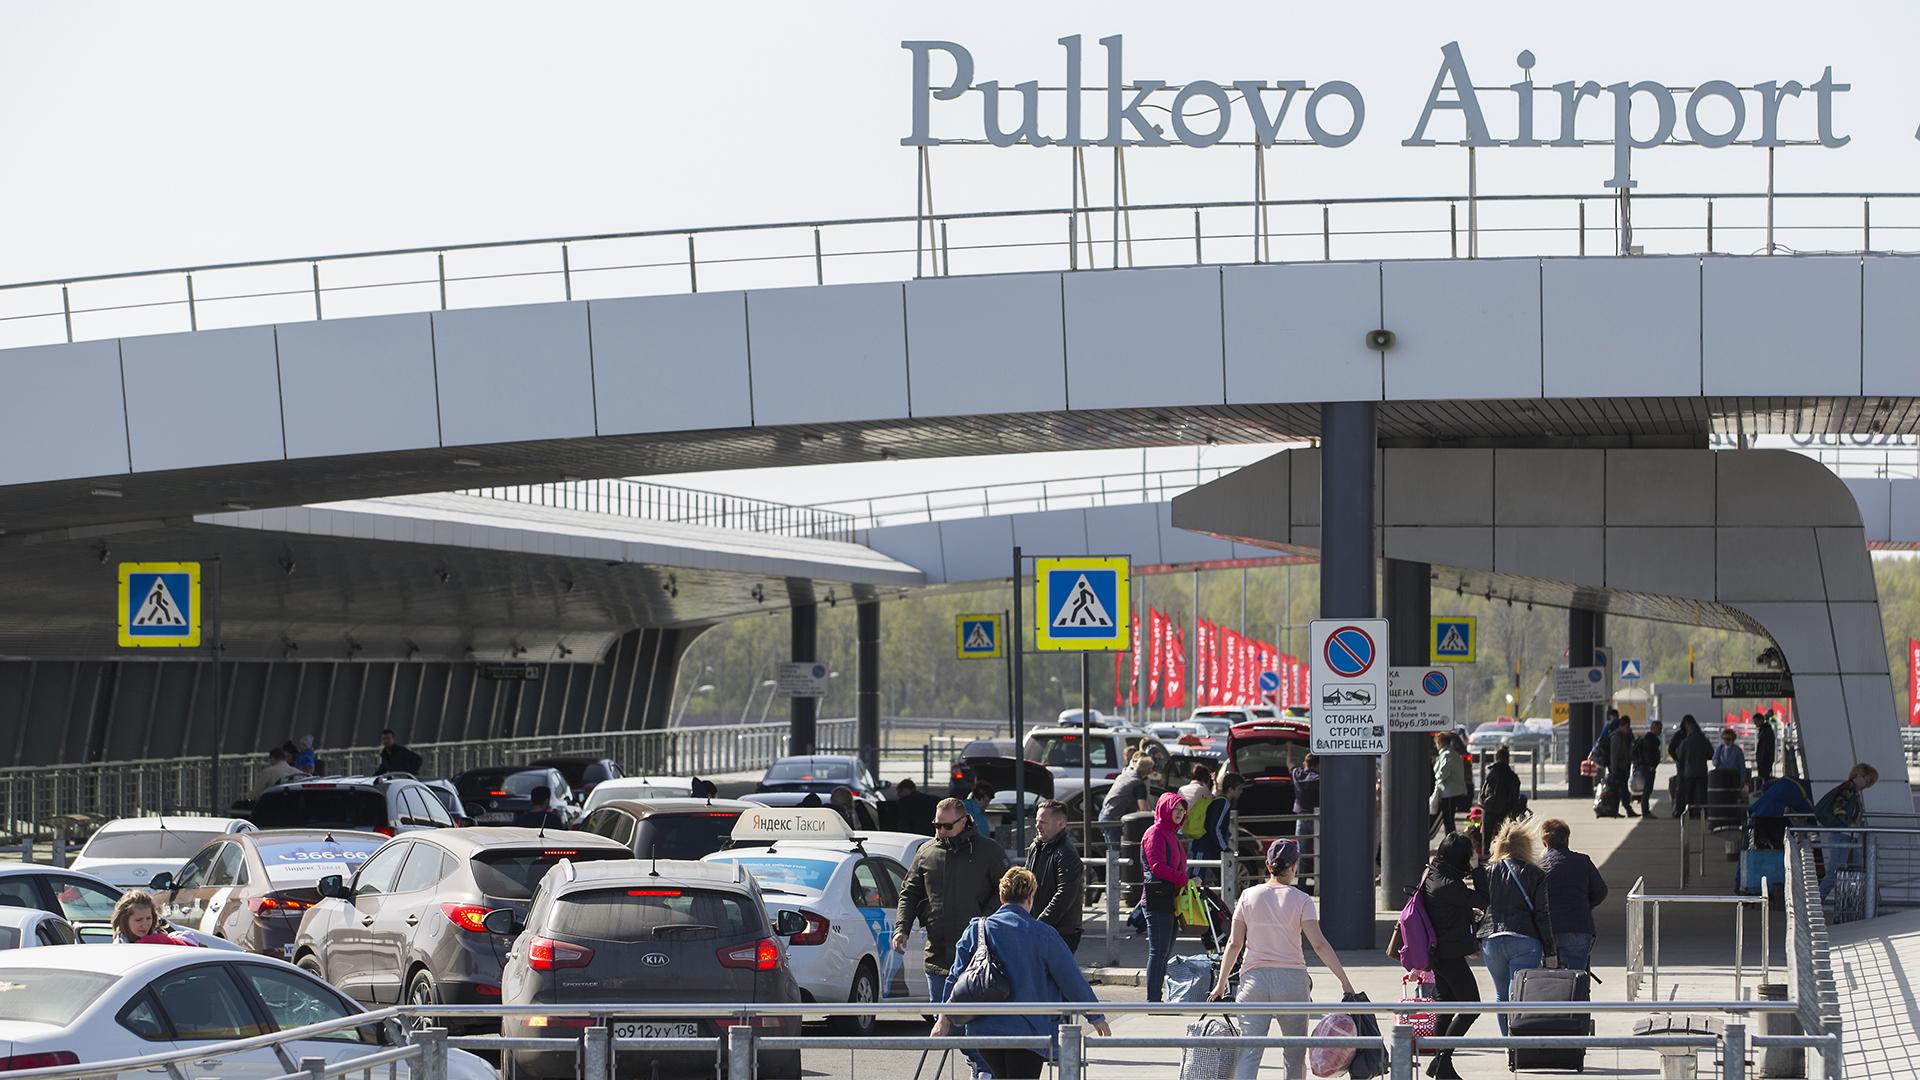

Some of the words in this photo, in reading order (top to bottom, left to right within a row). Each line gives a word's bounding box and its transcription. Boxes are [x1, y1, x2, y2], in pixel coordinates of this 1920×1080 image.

[901, 34, 1366, 150] Pulkovo
[1402, 41, 1851, 188] Airport
[1324, 714, 1374, 724] СТОЯНКА
[753, 814, 793, 832] Яндекс
[795, 815, 825, 832] Такси
[646, 955, 665, 964] KIA
[674, 1024, 695, 1035] 178
